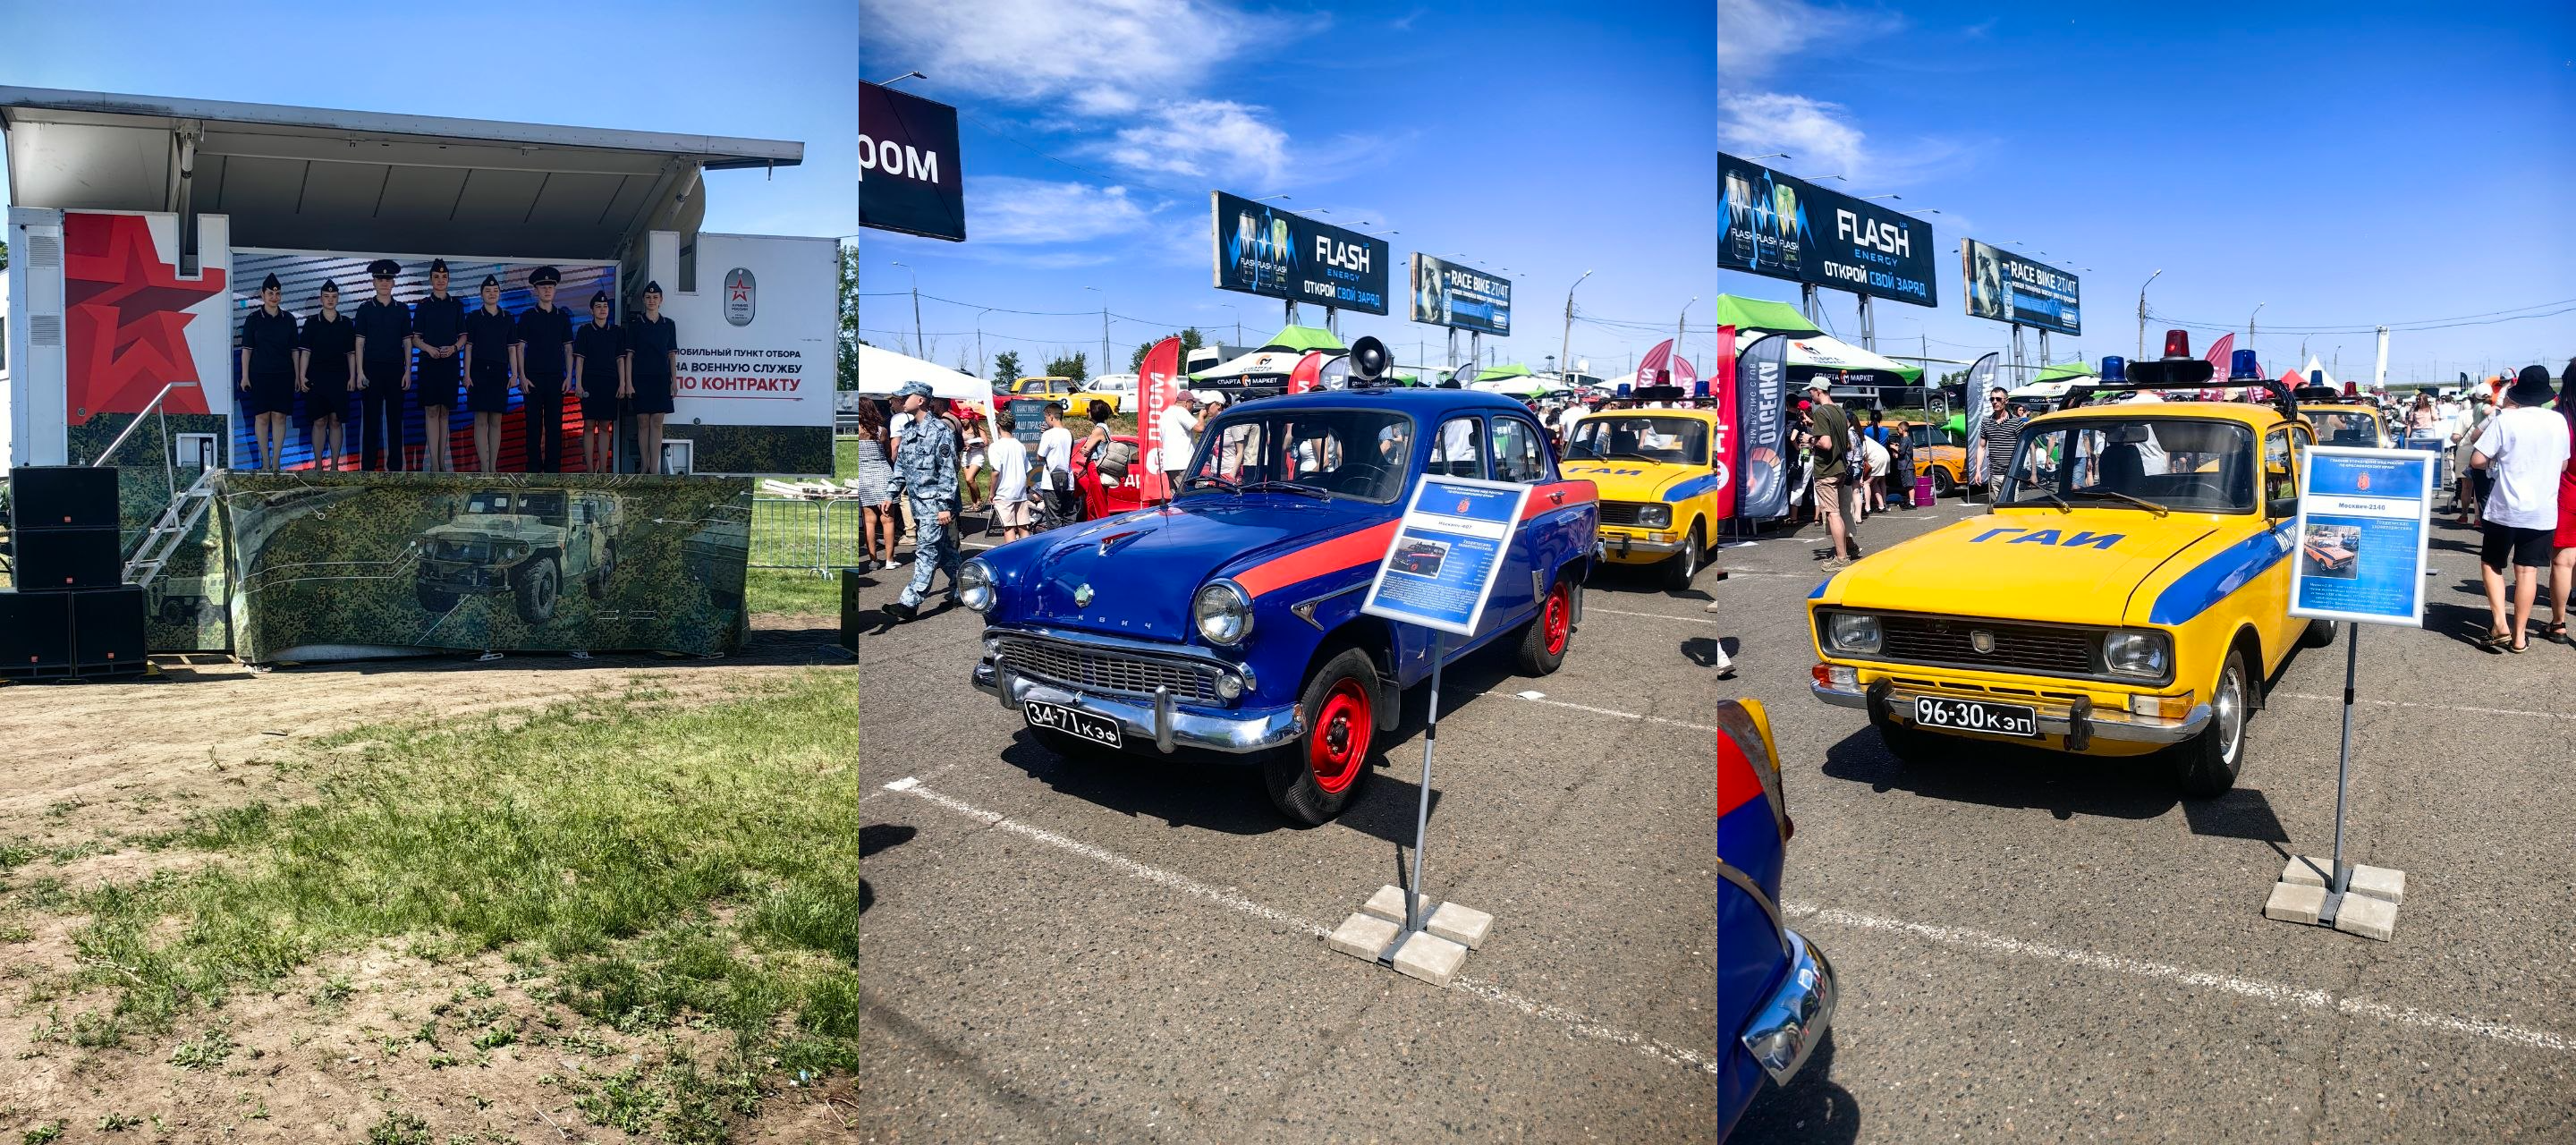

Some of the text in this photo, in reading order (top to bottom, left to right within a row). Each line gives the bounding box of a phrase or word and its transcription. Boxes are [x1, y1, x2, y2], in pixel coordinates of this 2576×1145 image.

[1836, 208, 1910, 259] FLASH
[1316, 234, 1370, 274] FLASH
[1855, 249, 1898, 267] ENERGY
[1326, 268, 1360, 282] ENERGY
[1451, 269, 1509, 299] RACE BIKE 2T/4T
[1825, 260, 1927, 298] ОТКРОЙ СВОЙ ЗАРЯД
[2011, 260, 2077, 296] RACE BIKE 2T/4T
[1304, 280, 1380, 308] ОТКРОЙ СВОЙ ЗАРЯД
[733, 350, 764, 358] ПУНКТ
[691, 362, 750, 373] ВОЕННУЮ
[753, 364, 802, 374] СЛУЖБУ
[1850, 374, 1874, 382] МАРКЕТ
[701, 377, 801, 392] КОНТРАКТУ
[1567, 467, 1643, 476] ГАИ
[1968, 528, 2127, 550] ГАИ
